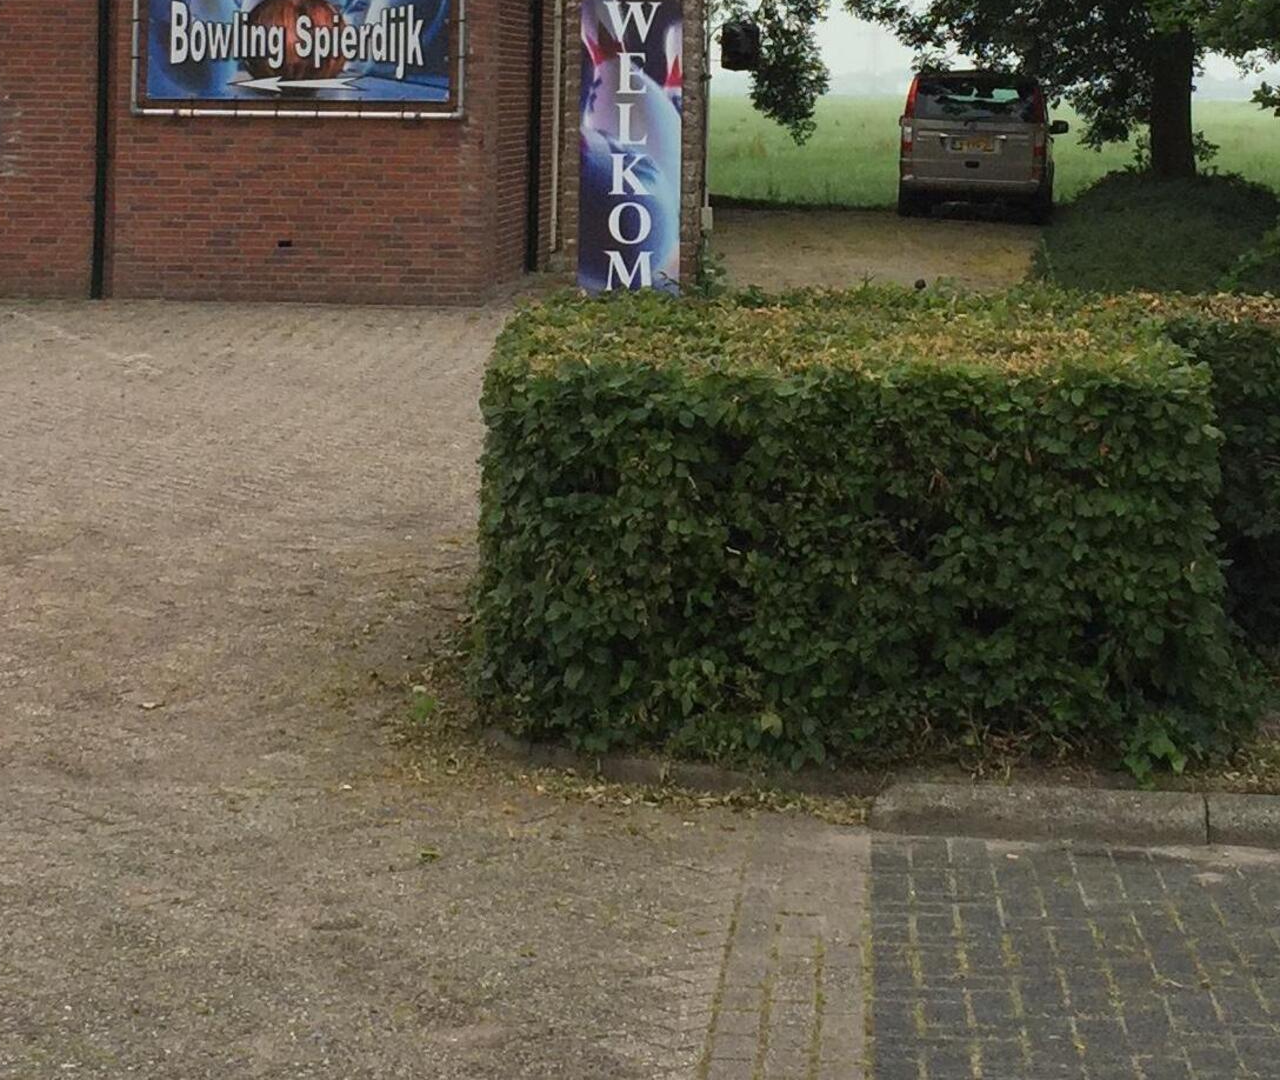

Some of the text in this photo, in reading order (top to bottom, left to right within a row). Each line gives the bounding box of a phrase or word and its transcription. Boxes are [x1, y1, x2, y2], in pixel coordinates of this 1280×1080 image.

[170, 0, 424, 80] Bowling Spierdijk
[603, 1, 662, 292] WELKOM
